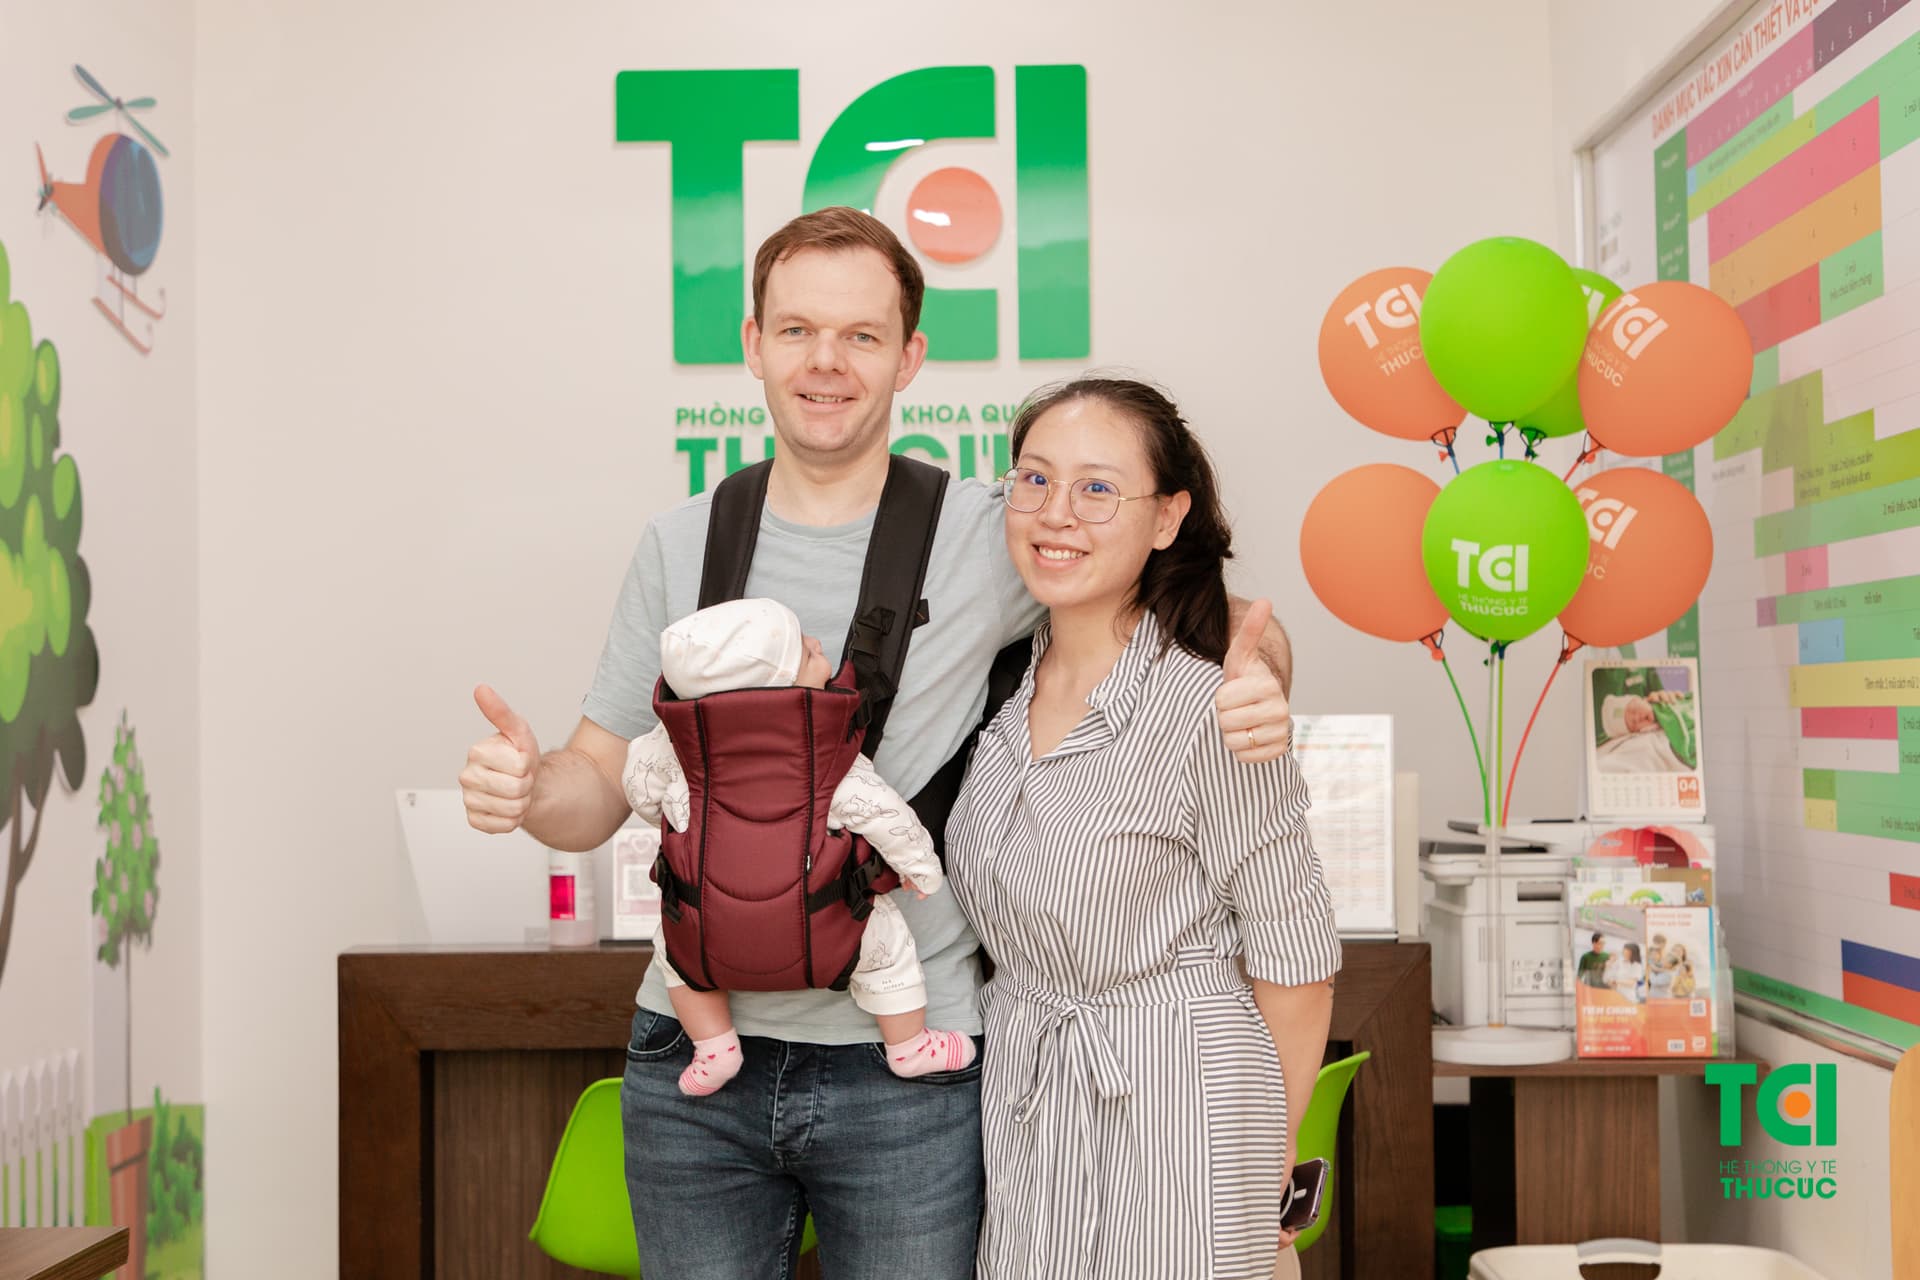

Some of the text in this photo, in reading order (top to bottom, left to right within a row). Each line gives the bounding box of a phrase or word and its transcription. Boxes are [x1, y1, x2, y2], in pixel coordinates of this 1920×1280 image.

[1343, 283, 1422, 350] TCI
[676, 400, 765, 426] PHÒNG
[902, 405, 971, 424] KHOA
[1451, 538, 1530, 592] TCI
[1679, 779, 1697, 791] 04
